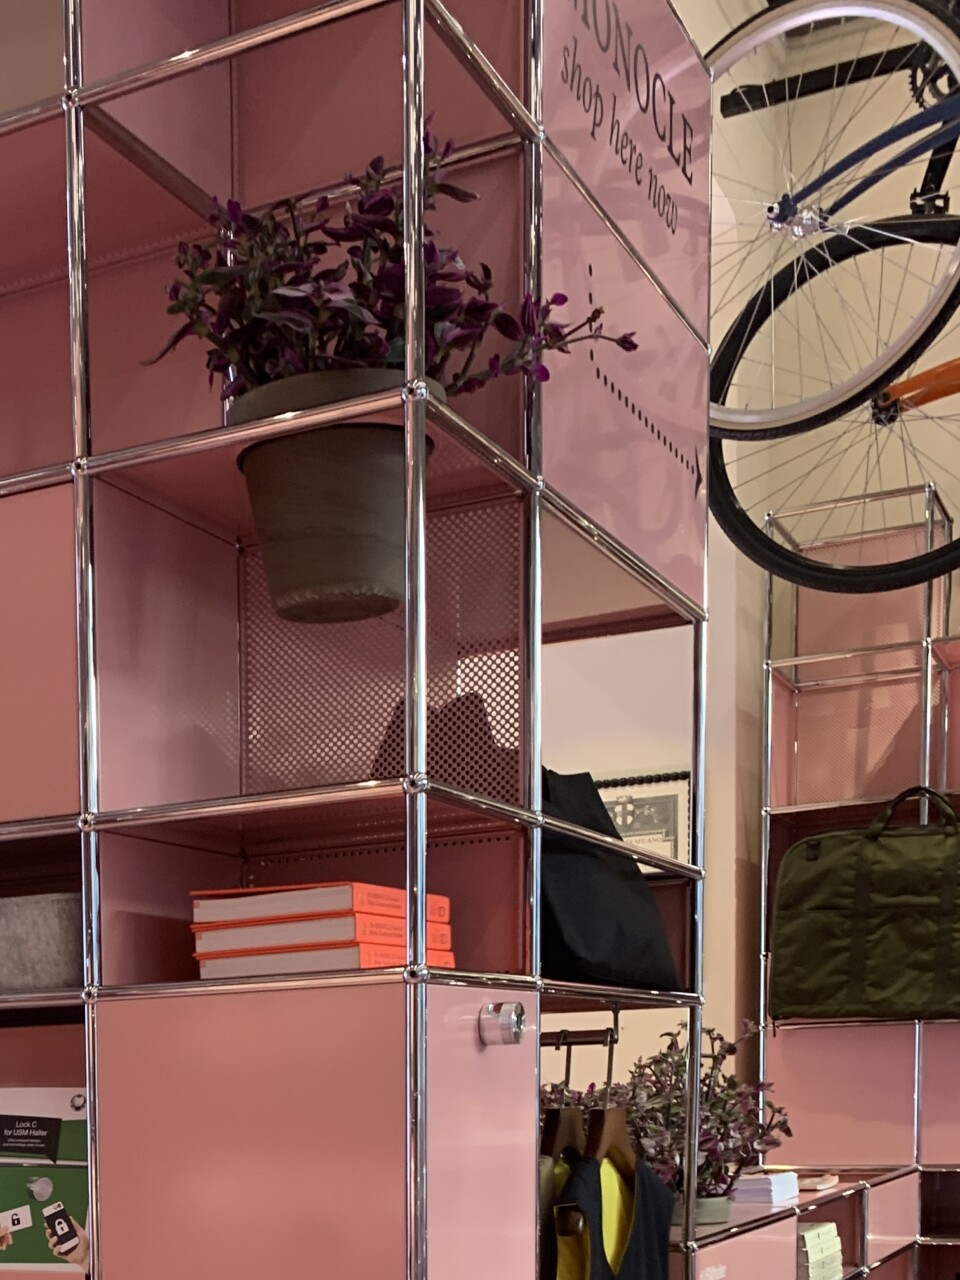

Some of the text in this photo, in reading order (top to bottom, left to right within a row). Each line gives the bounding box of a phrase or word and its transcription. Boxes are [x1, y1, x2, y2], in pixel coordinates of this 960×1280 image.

[561, 36, 680, 236] shop here now
[15, 1120, 38, 1128] Lock C
[3, 1128, 48, 1136] for USM Haller
